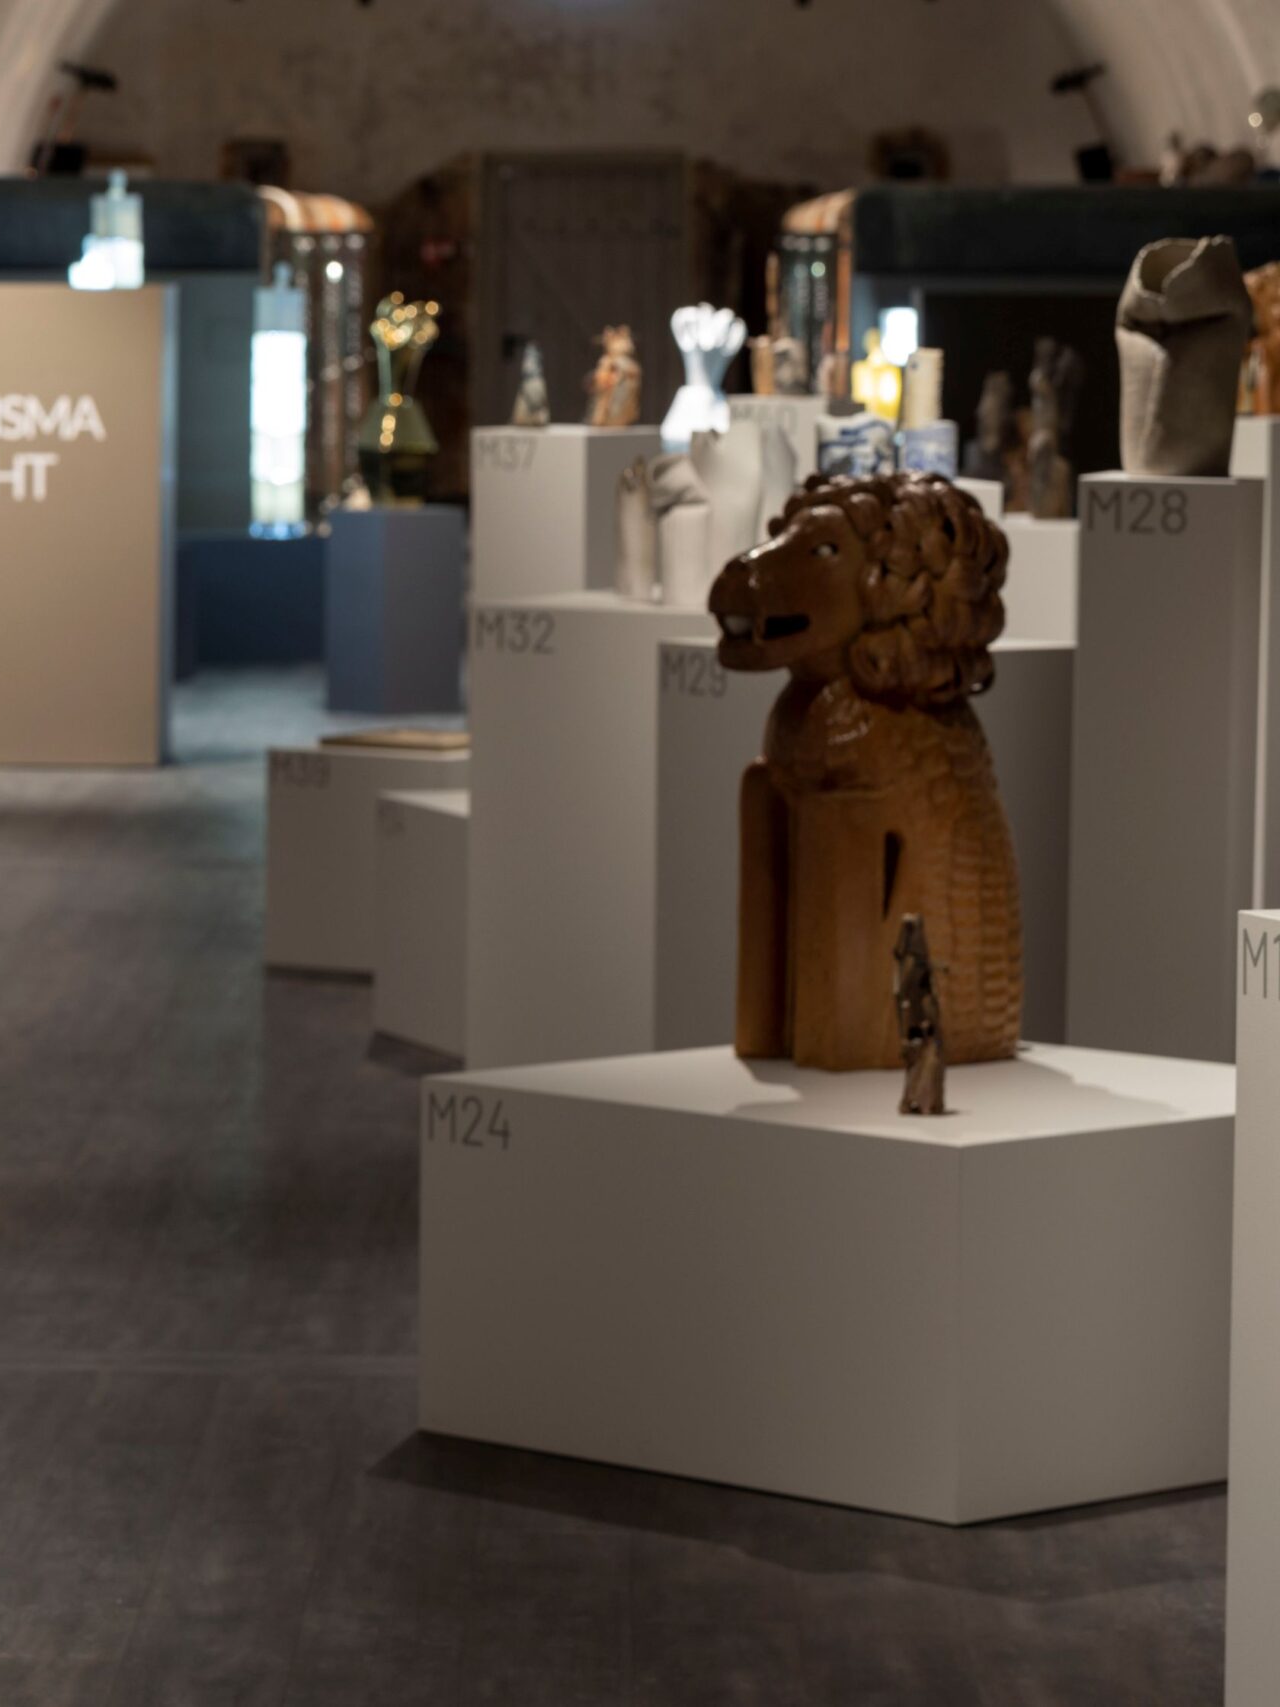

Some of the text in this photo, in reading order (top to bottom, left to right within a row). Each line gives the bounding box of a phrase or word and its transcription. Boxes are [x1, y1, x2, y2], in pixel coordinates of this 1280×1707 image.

[474, 437, 537, 472] M37
[1087, 487, 1189, 535] M28
[475, 610, 556, 654] M32
[426, 1092, 511, 1150] M24
